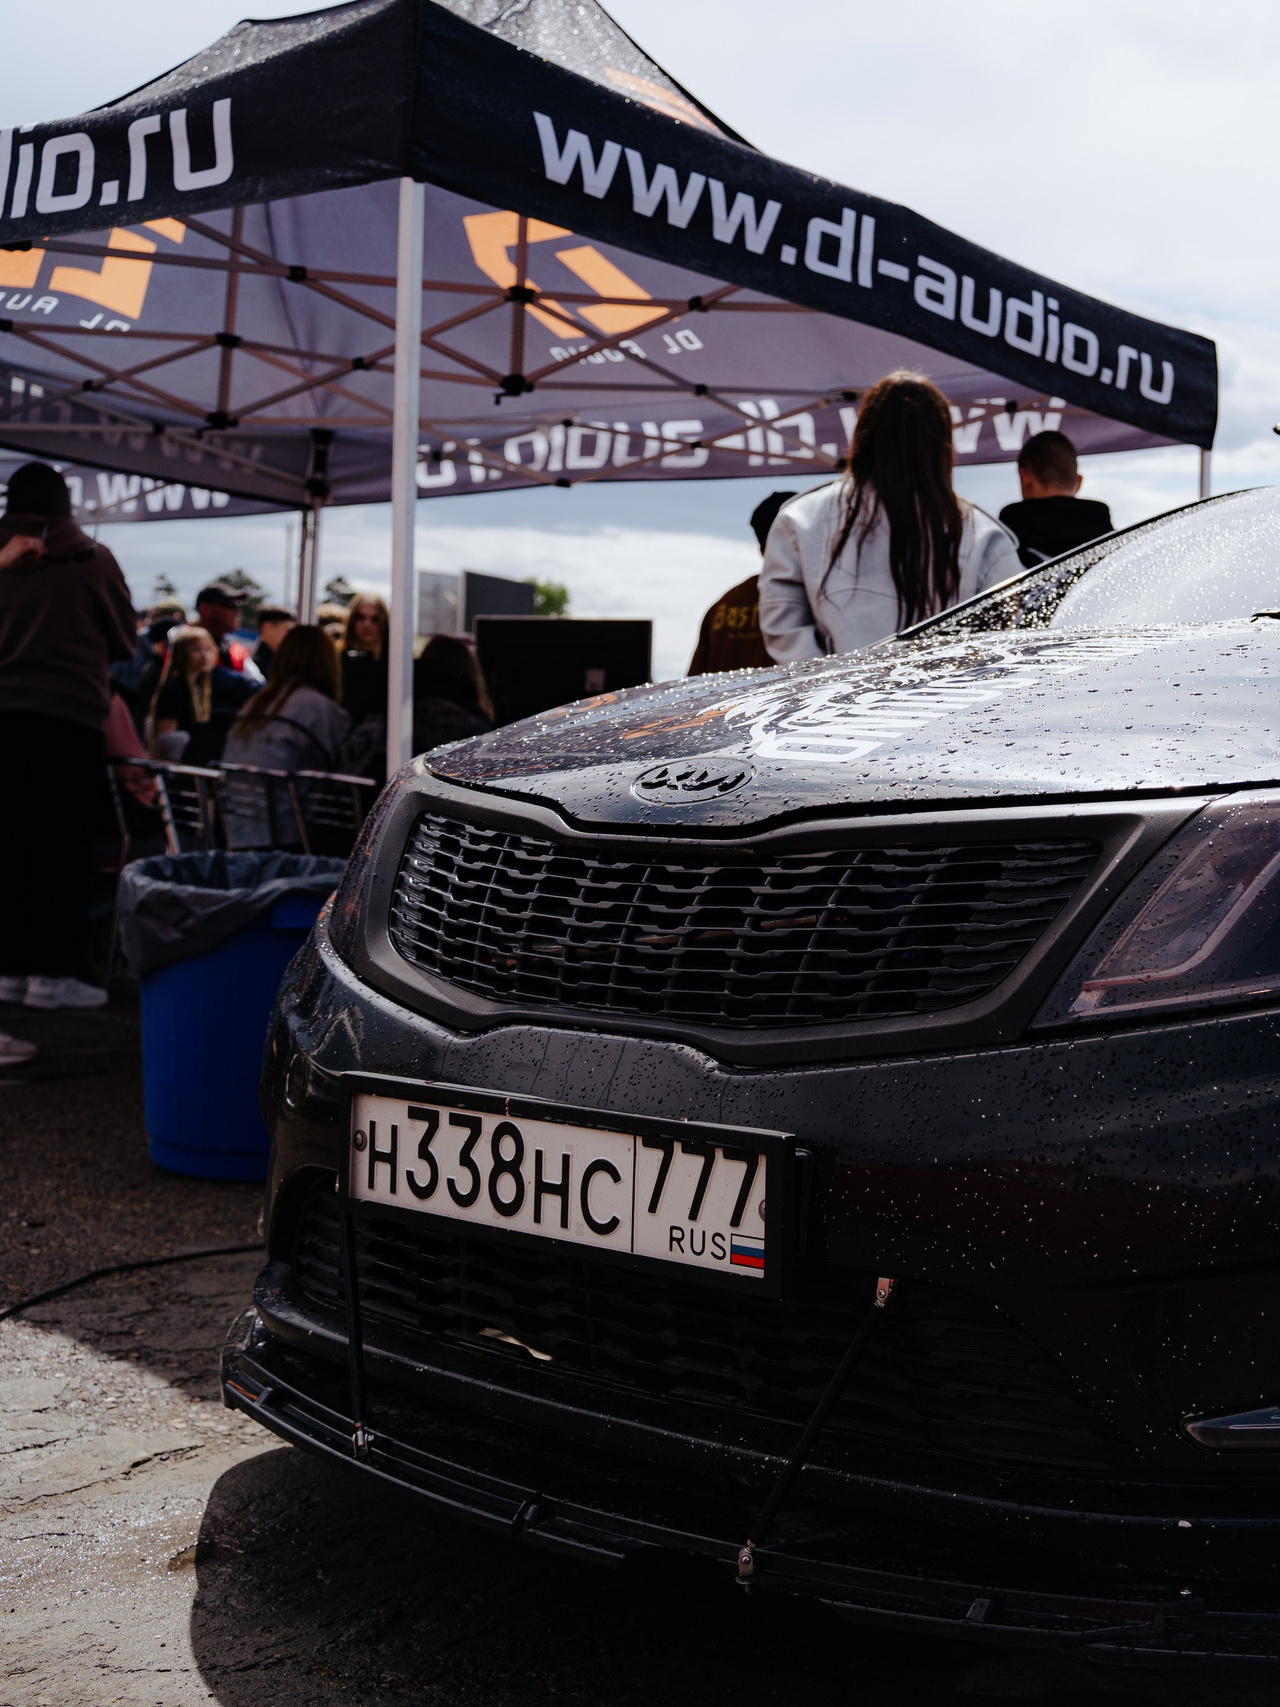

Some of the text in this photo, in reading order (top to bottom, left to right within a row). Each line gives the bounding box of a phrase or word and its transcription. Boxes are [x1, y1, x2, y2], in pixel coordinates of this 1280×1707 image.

[533, 111, 1174, 404] www.dl-audio.ru
[641, 1135, 760, 1228] 777
[668, 1225, 727, 1261] RUS
